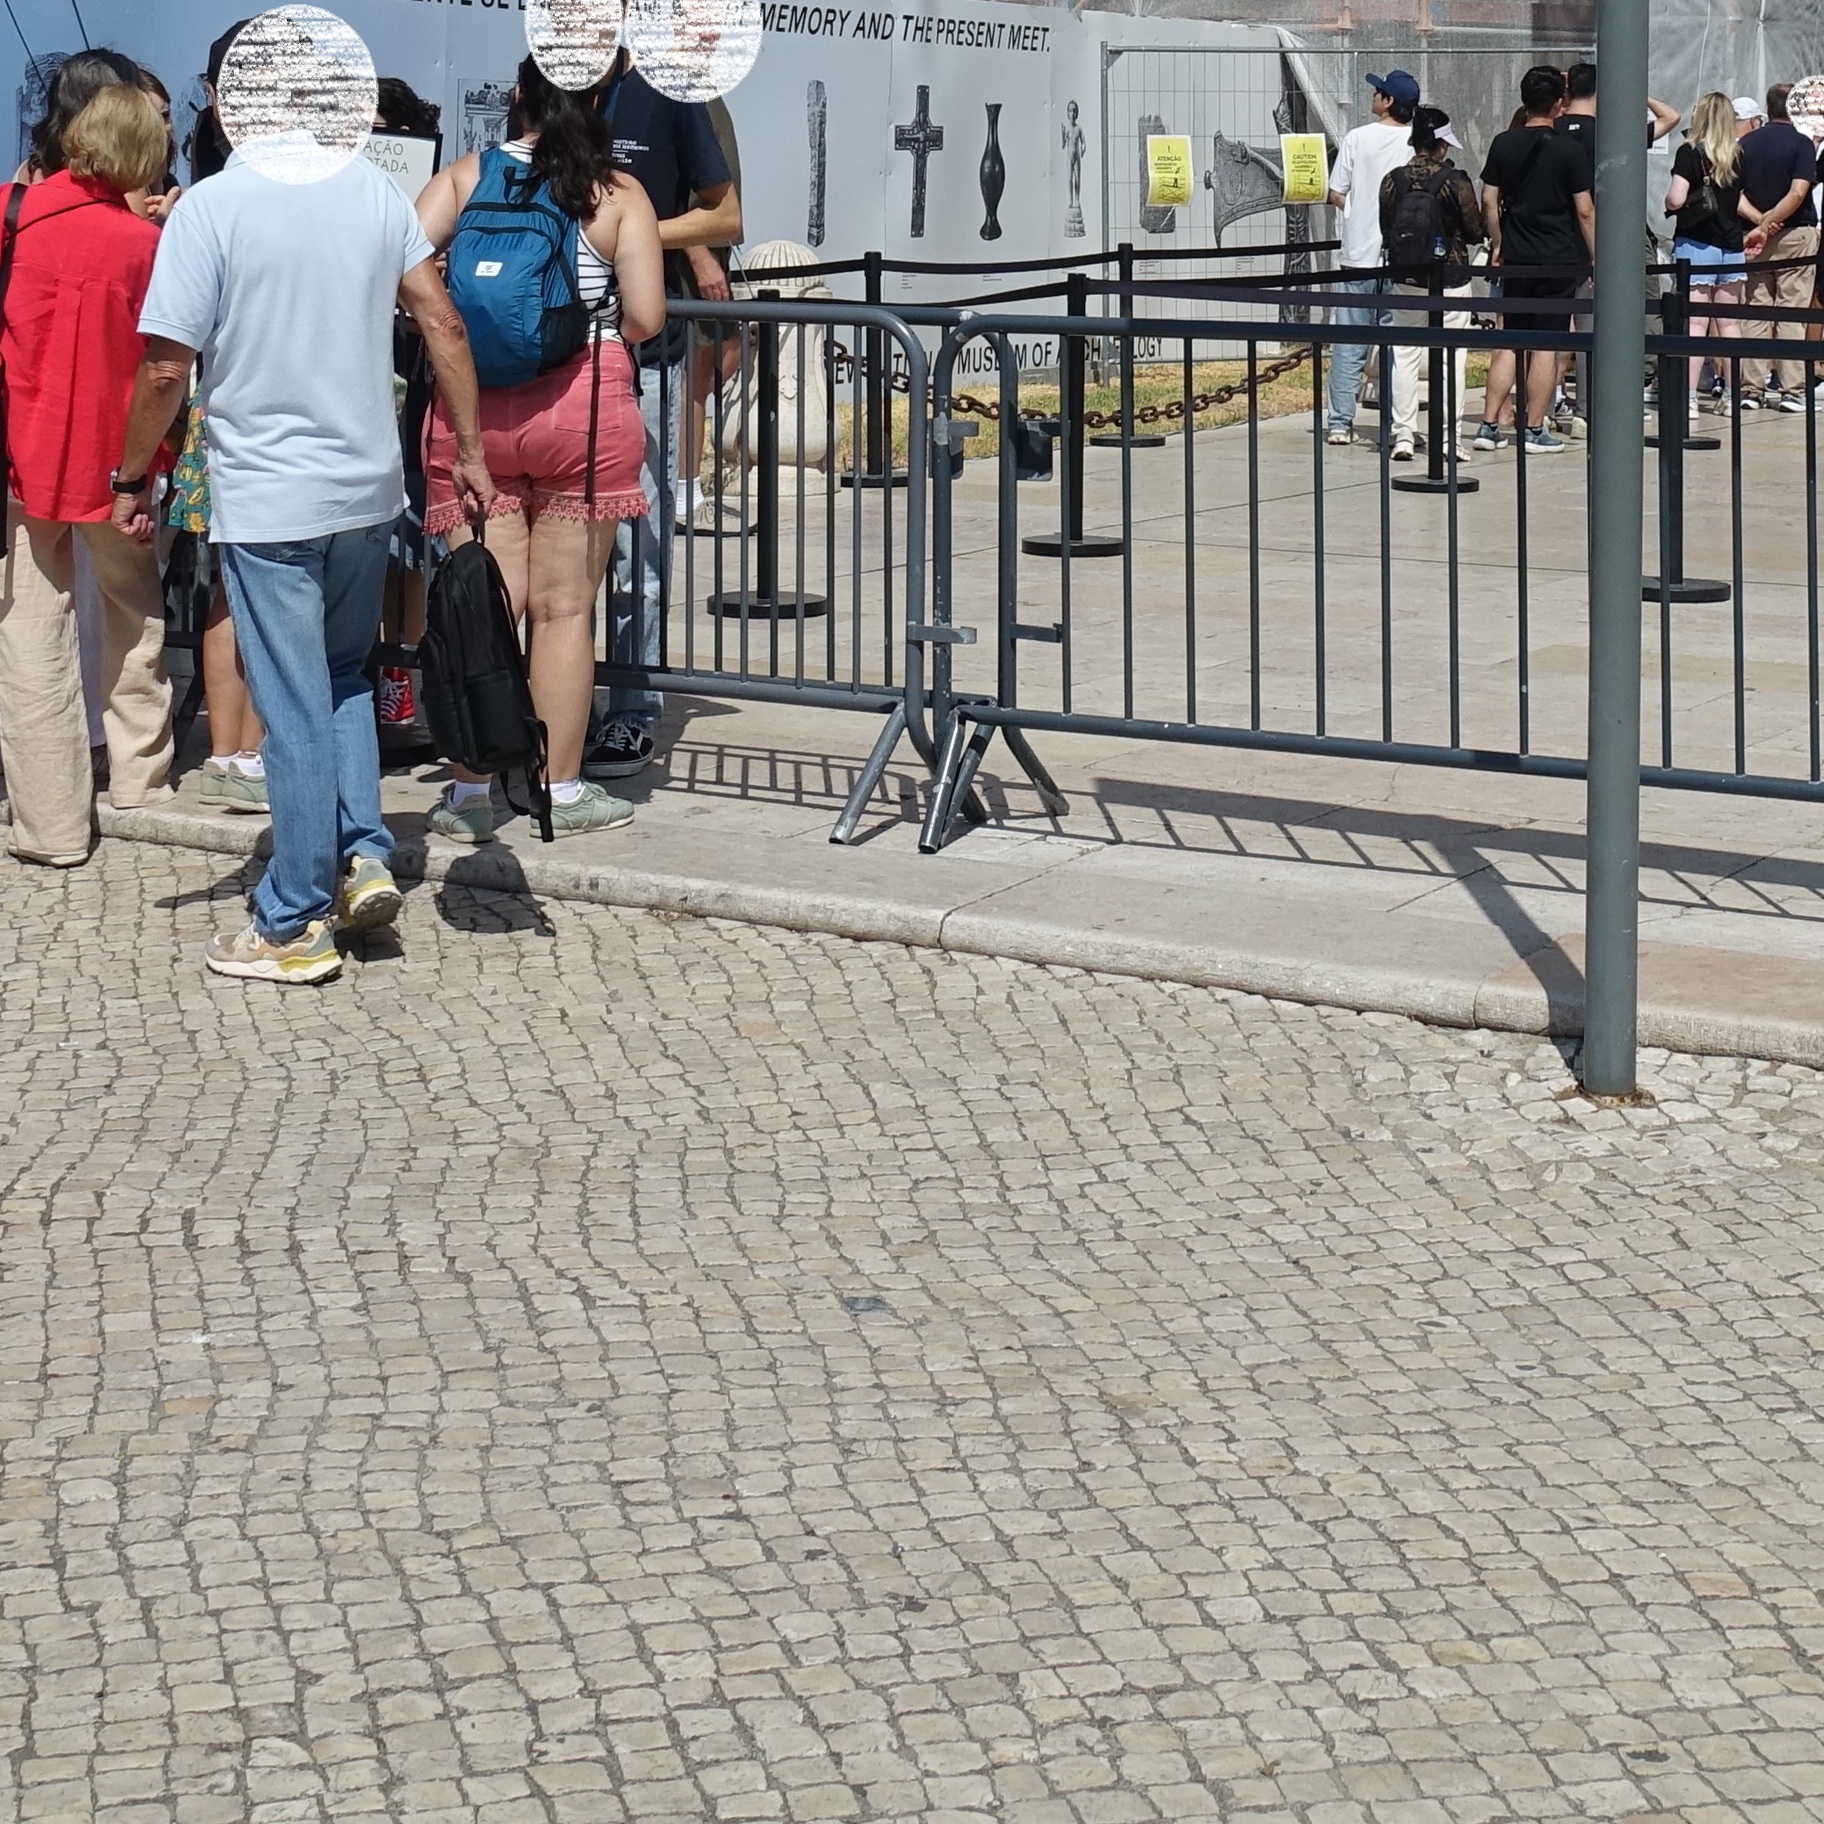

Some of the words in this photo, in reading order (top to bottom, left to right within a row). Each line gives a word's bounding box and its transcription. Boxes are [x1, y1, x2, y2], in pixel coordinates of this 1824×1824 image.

[760, 3, 852, 37] MEMORY
[852, 11, 895, 40] AND
[902, 15, 933, 43] THE
[936, 17, 1006, 49] PRESENT
[1007, 24, 1051, 52] MEET.
[1032, 340, 1053, 368] OF
